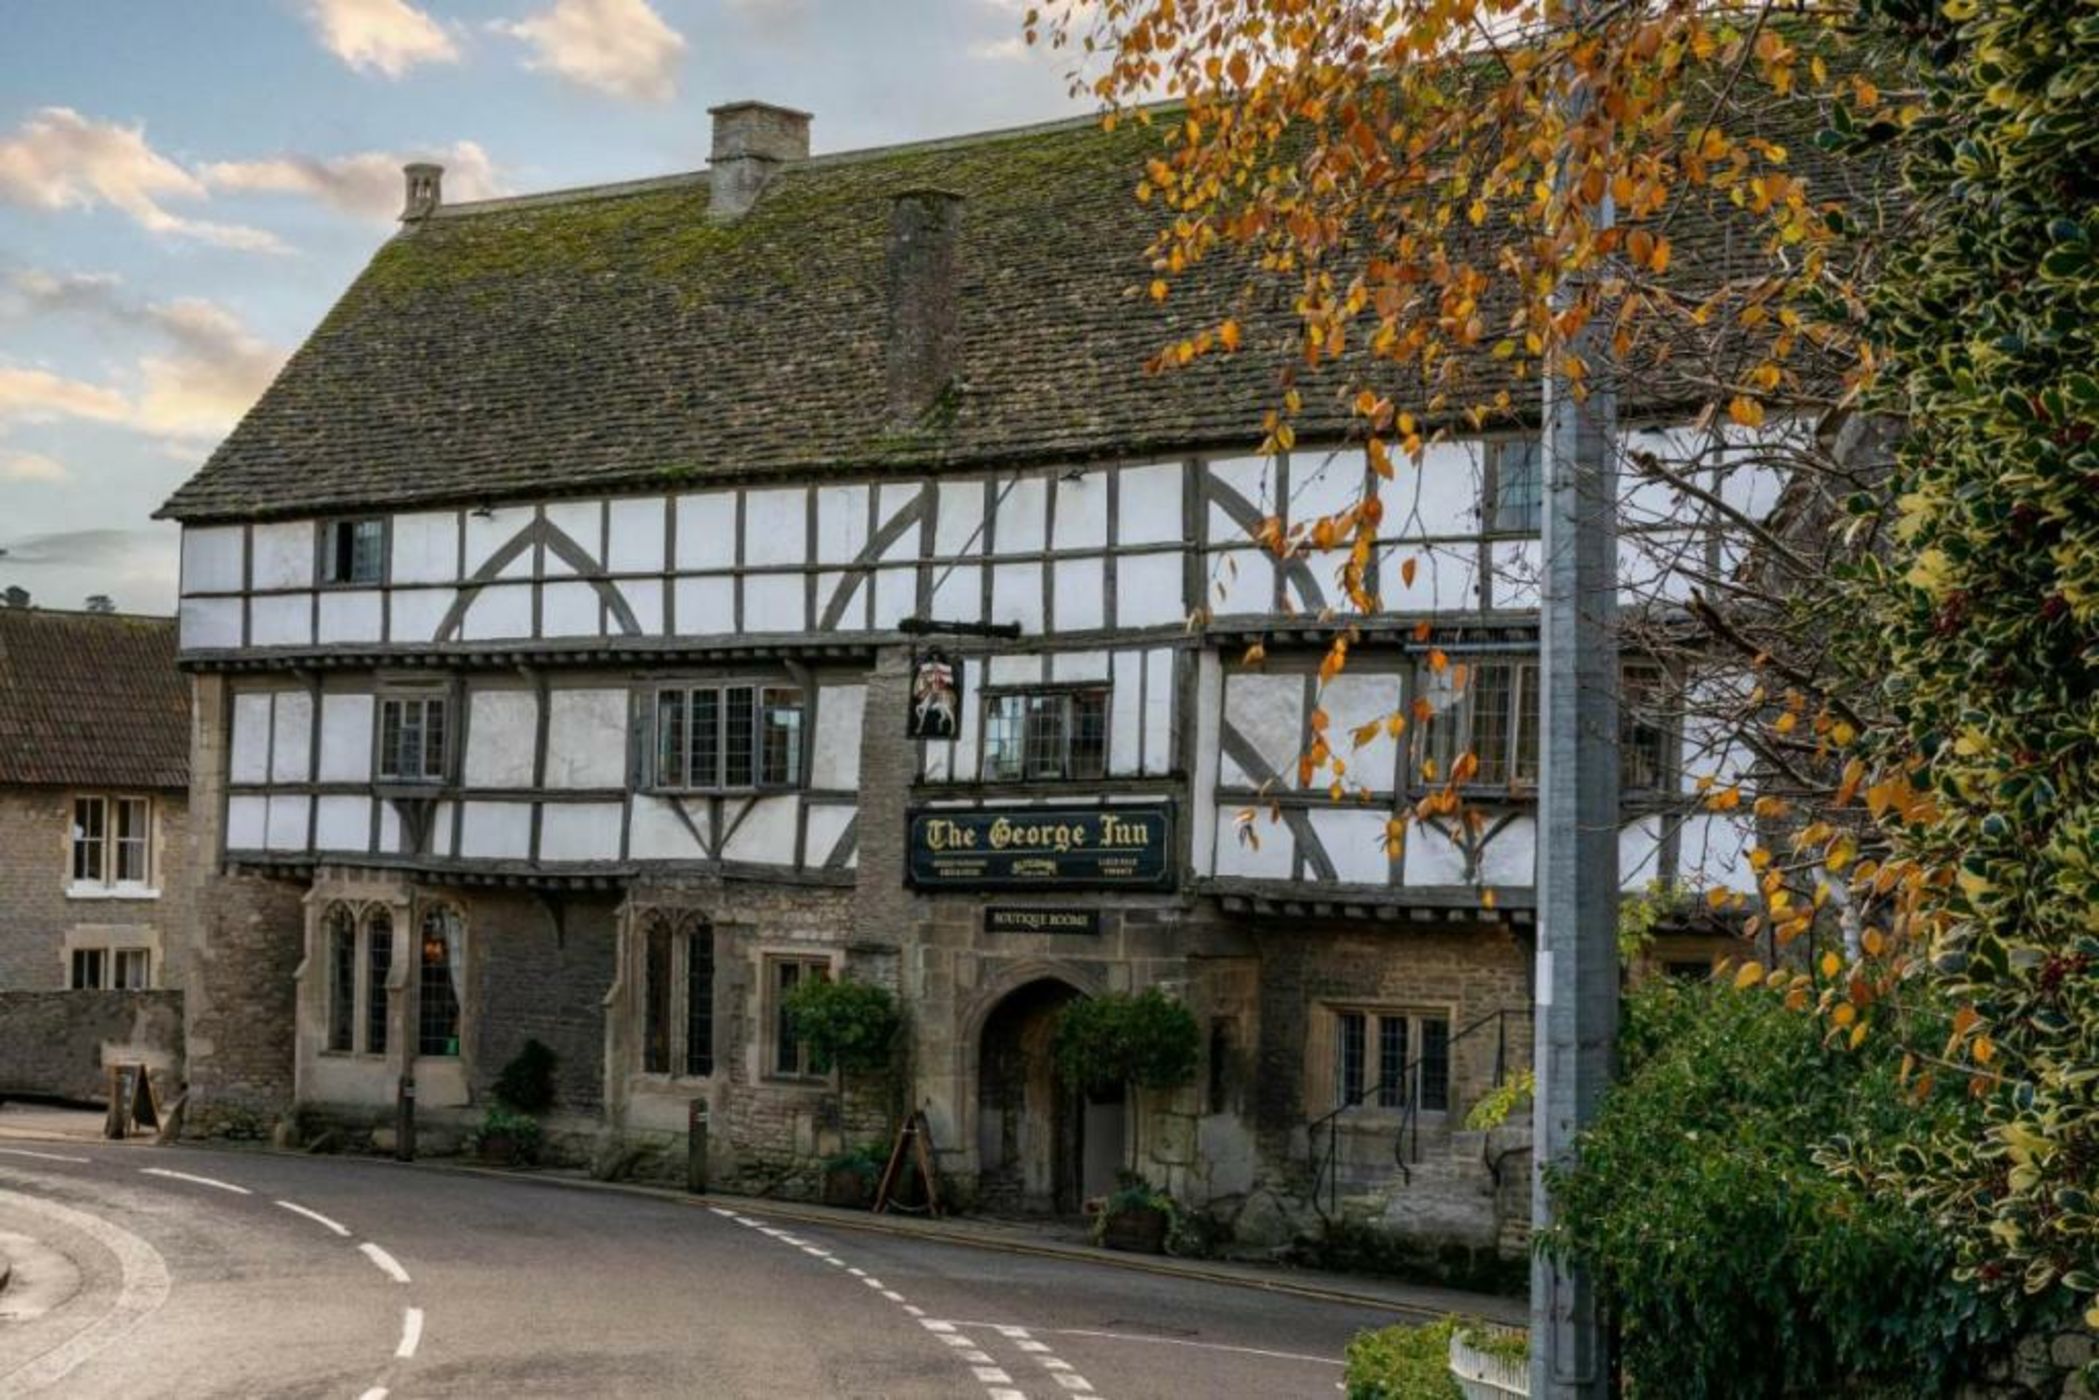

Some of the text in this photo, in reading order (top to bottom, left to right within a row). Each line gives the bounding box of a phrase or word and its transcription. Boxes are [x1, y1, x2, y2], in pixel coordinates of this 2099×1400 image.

[927, 814, 1149, 851] The George Inn
[994, 911, 1046, 928] BOUTIQUE
